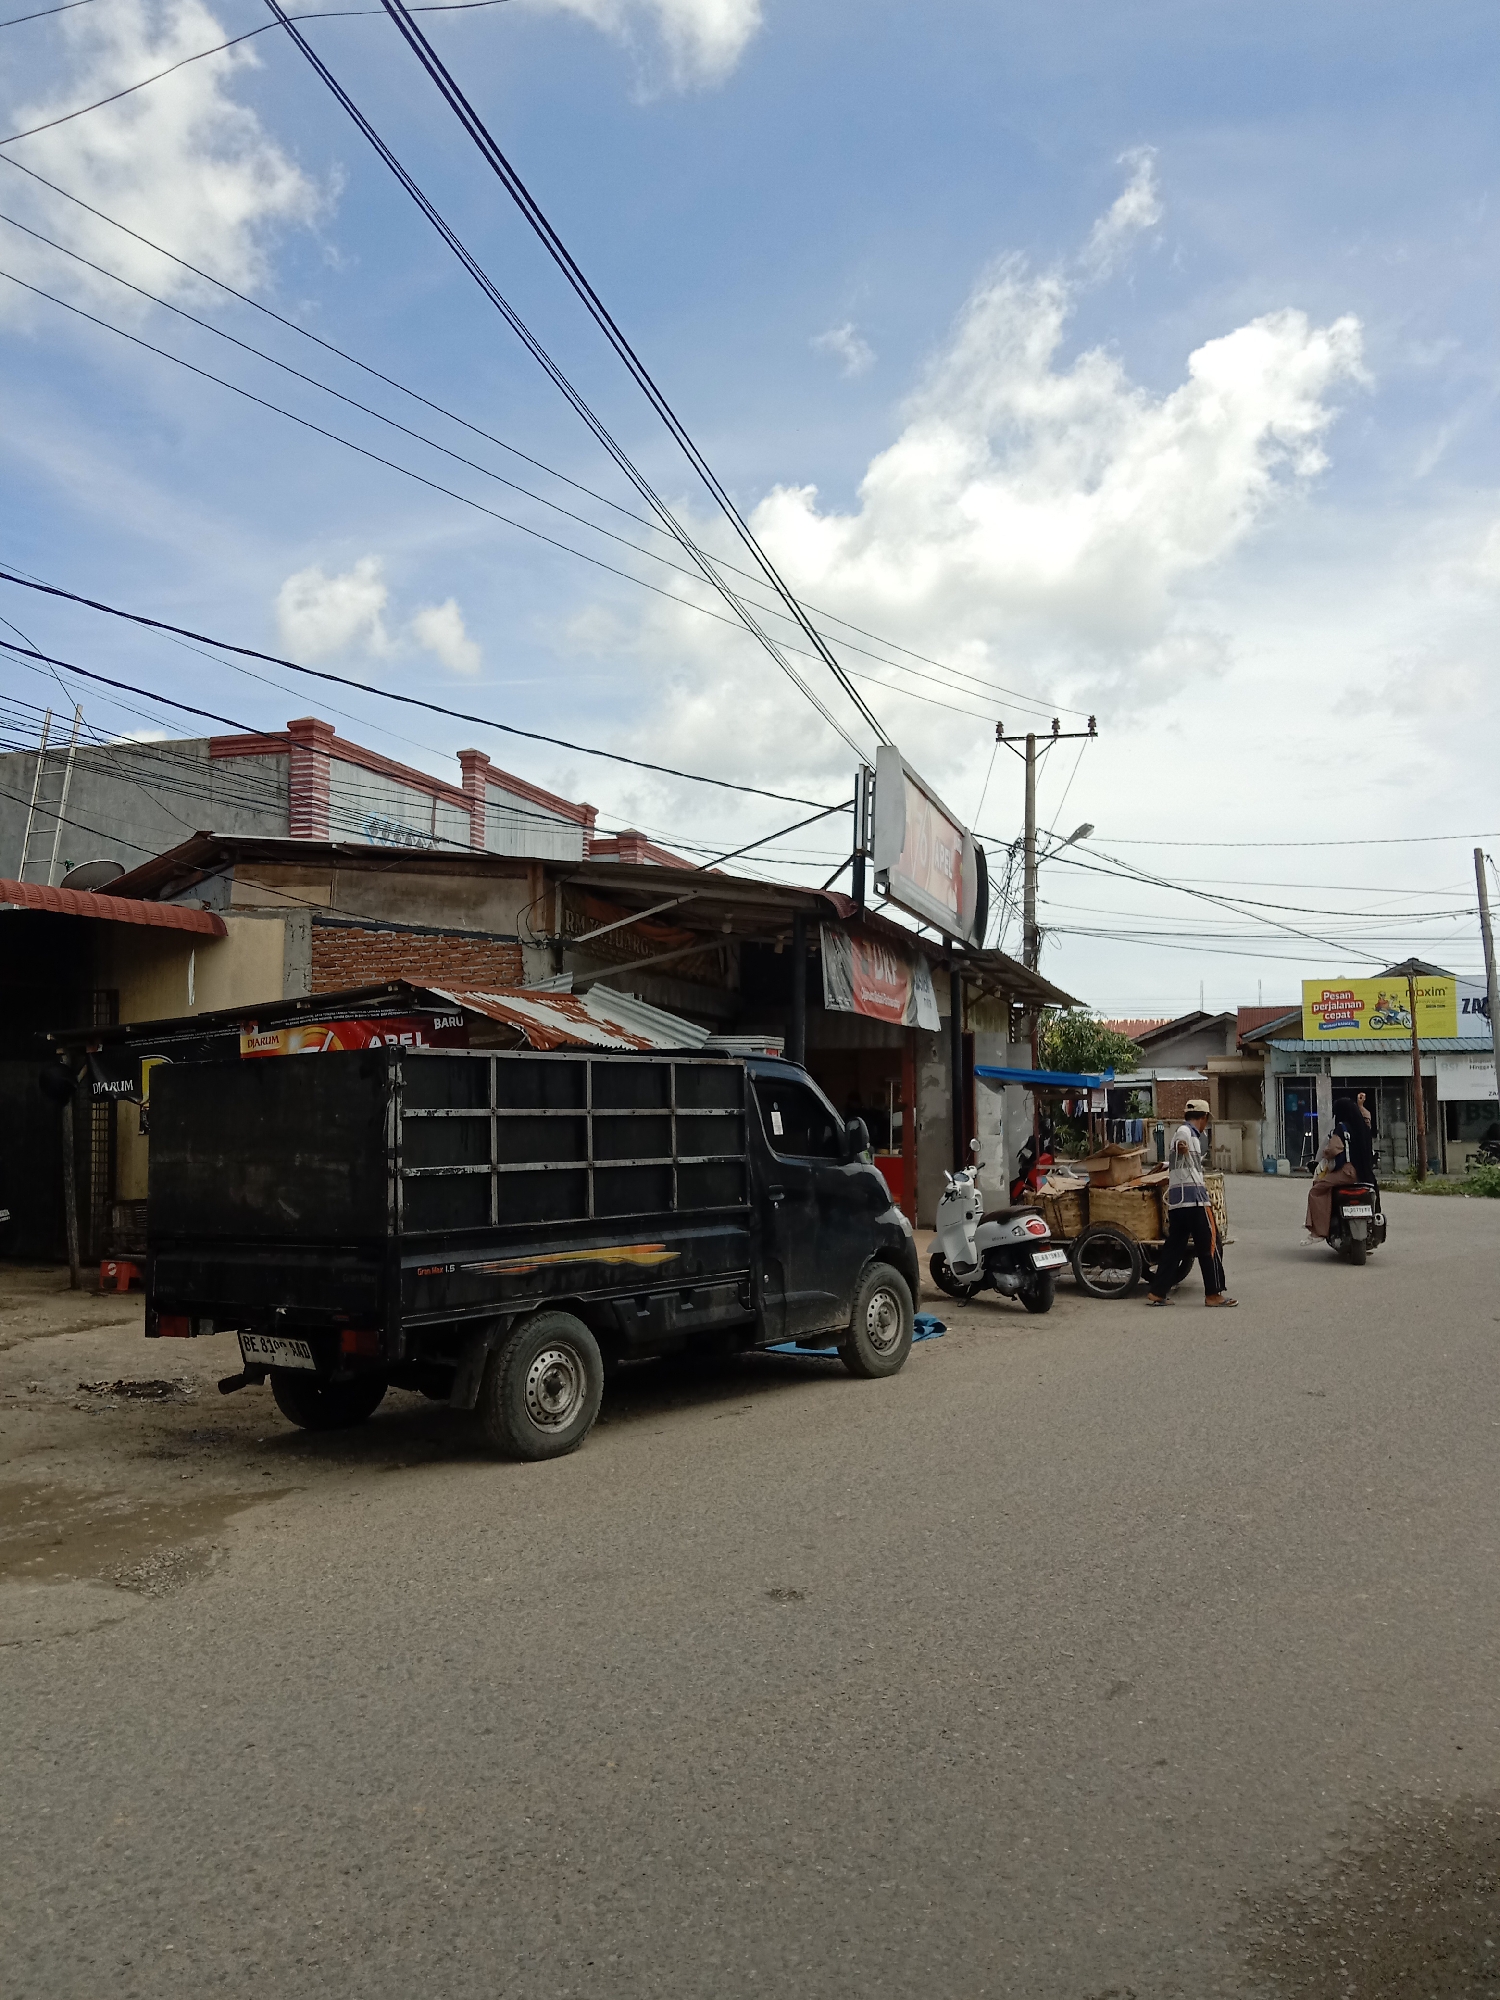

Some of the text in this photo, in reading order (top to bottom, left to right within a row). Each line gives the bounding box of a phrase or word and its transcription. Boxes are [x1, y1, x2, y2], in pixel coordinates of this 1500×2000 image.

[934, 837, 953, 880] APEL
[564, 909, 587, 934] RM
[1323, 991, 1351, 1001] Pesan
[1313, 1000, 1363, 1013] perjalanan
[433, 1015, 465, 1030] BARU
[1324, 1011, 1351, 1022] cepat
[247, 1034, 280, 1049] DJARUM
[92, 1079, 135, 1095] DJARUM
[445, 1264, 456, 1273] 1.5
[243, 1335, 260, 1353] BE
